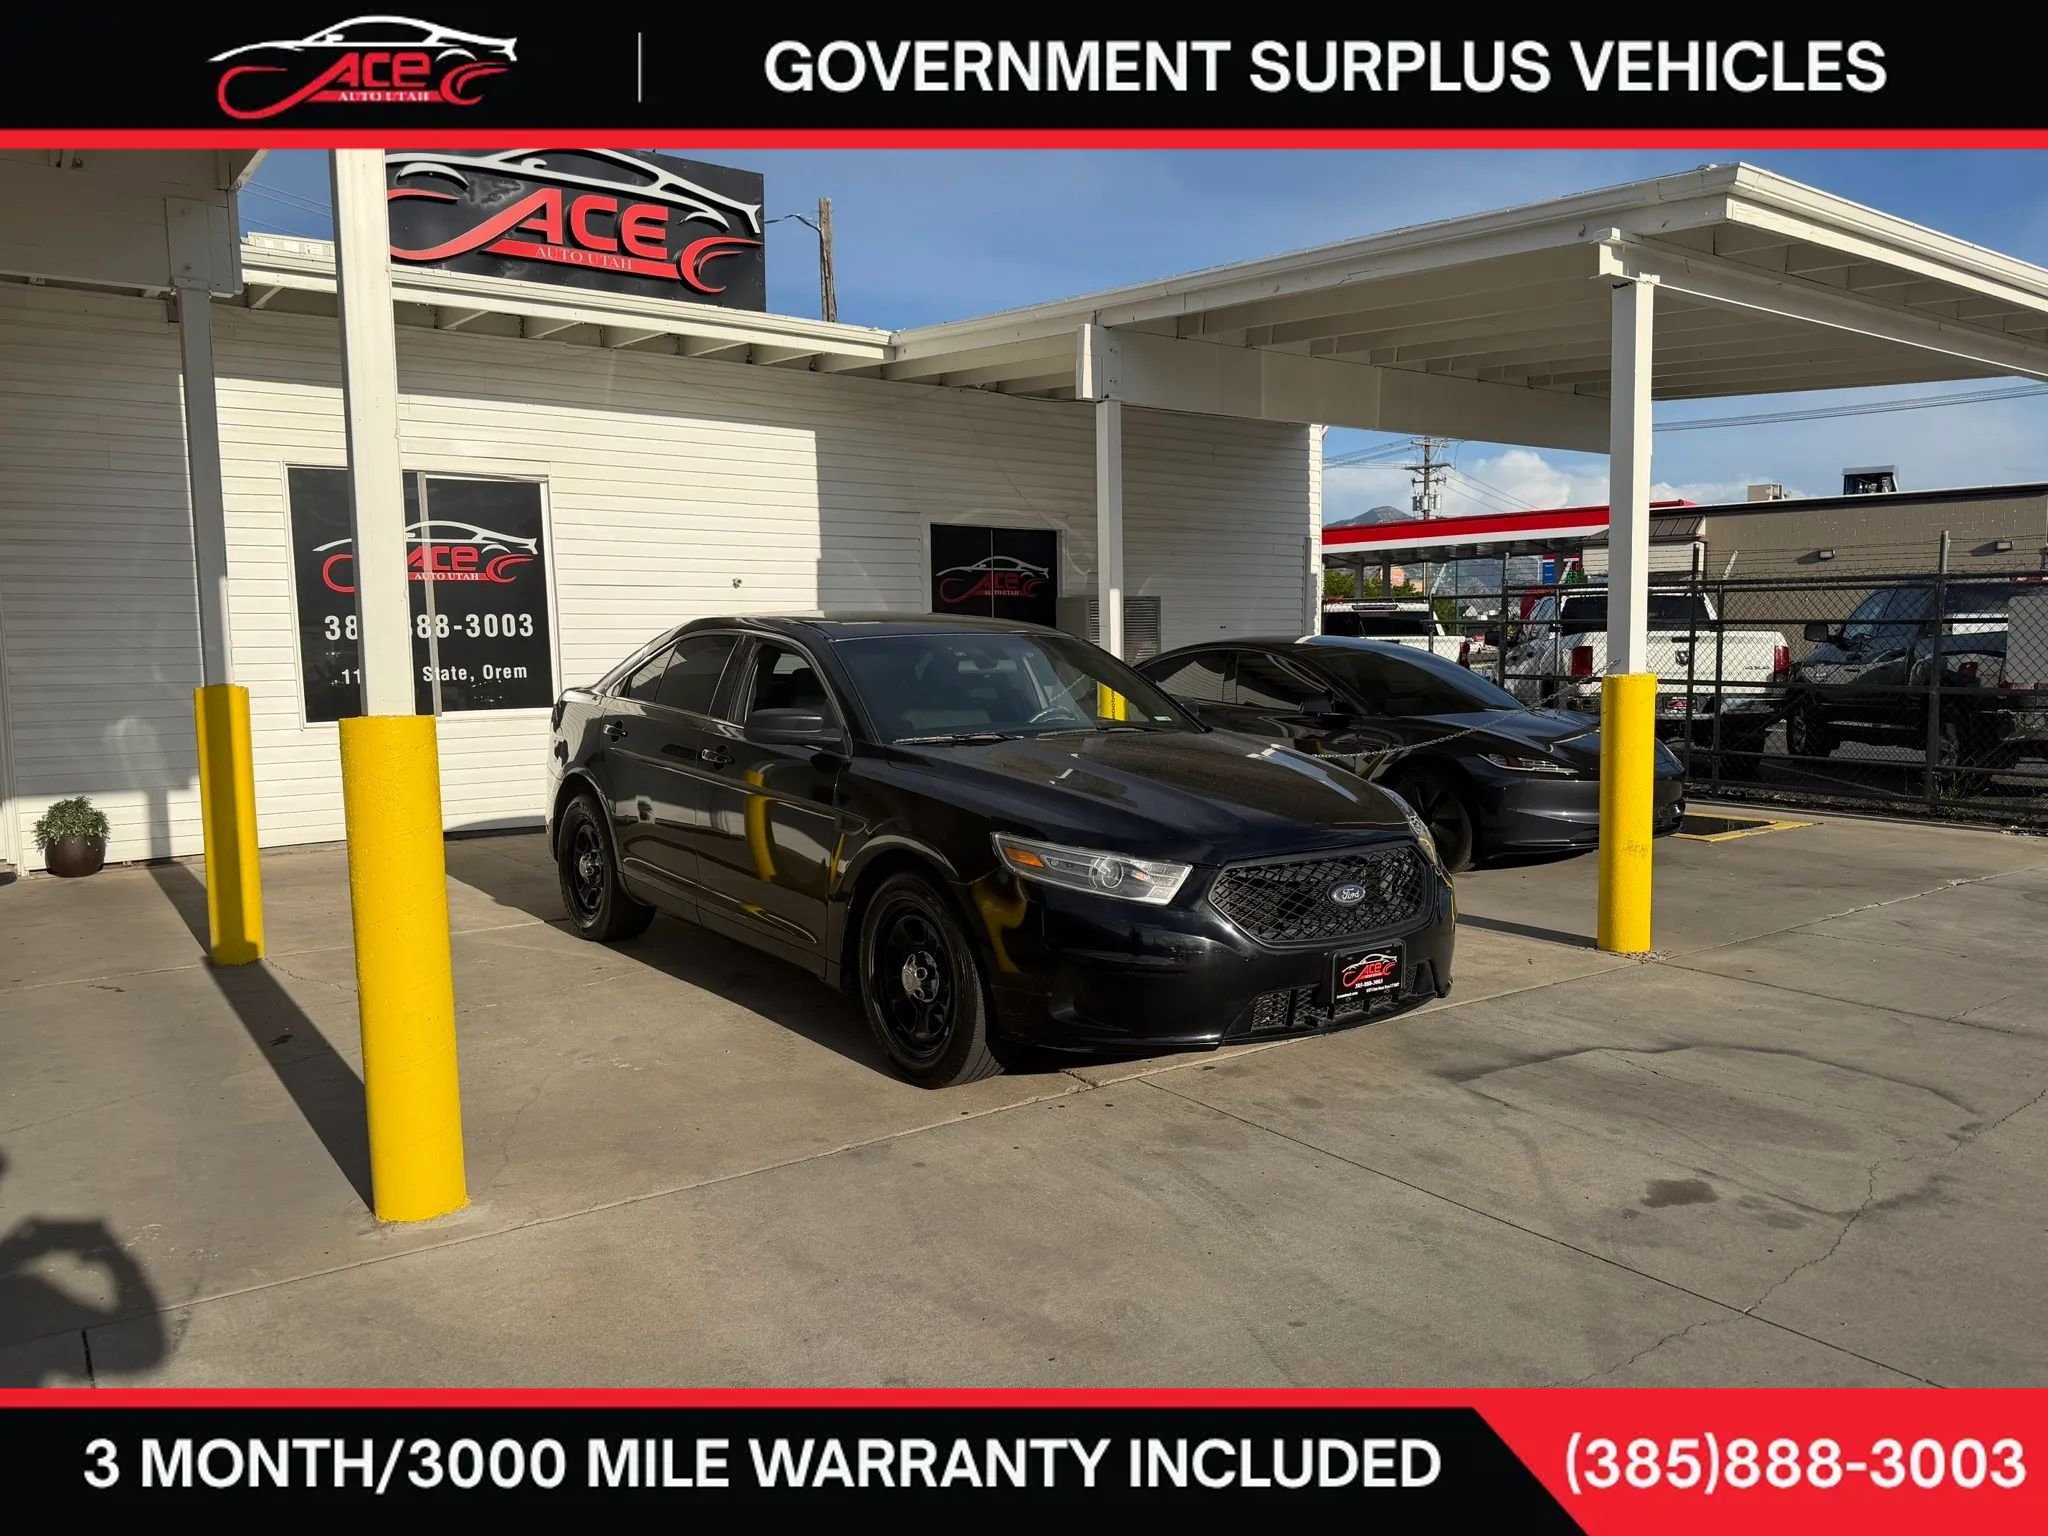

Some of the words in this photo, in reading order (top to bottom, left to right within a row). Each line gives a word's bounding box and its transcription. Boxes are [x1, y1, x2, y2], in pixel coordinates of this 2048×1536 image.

[510, 187, 668, 260] ACE
[535, 246, 583, 263] AUTO
[588, 255, 632, 270] UTAH
[422, 666, 475, 682] State,
[483, 664, 528, 680] Orem
[1342, 888, 1360, 899] Ford
